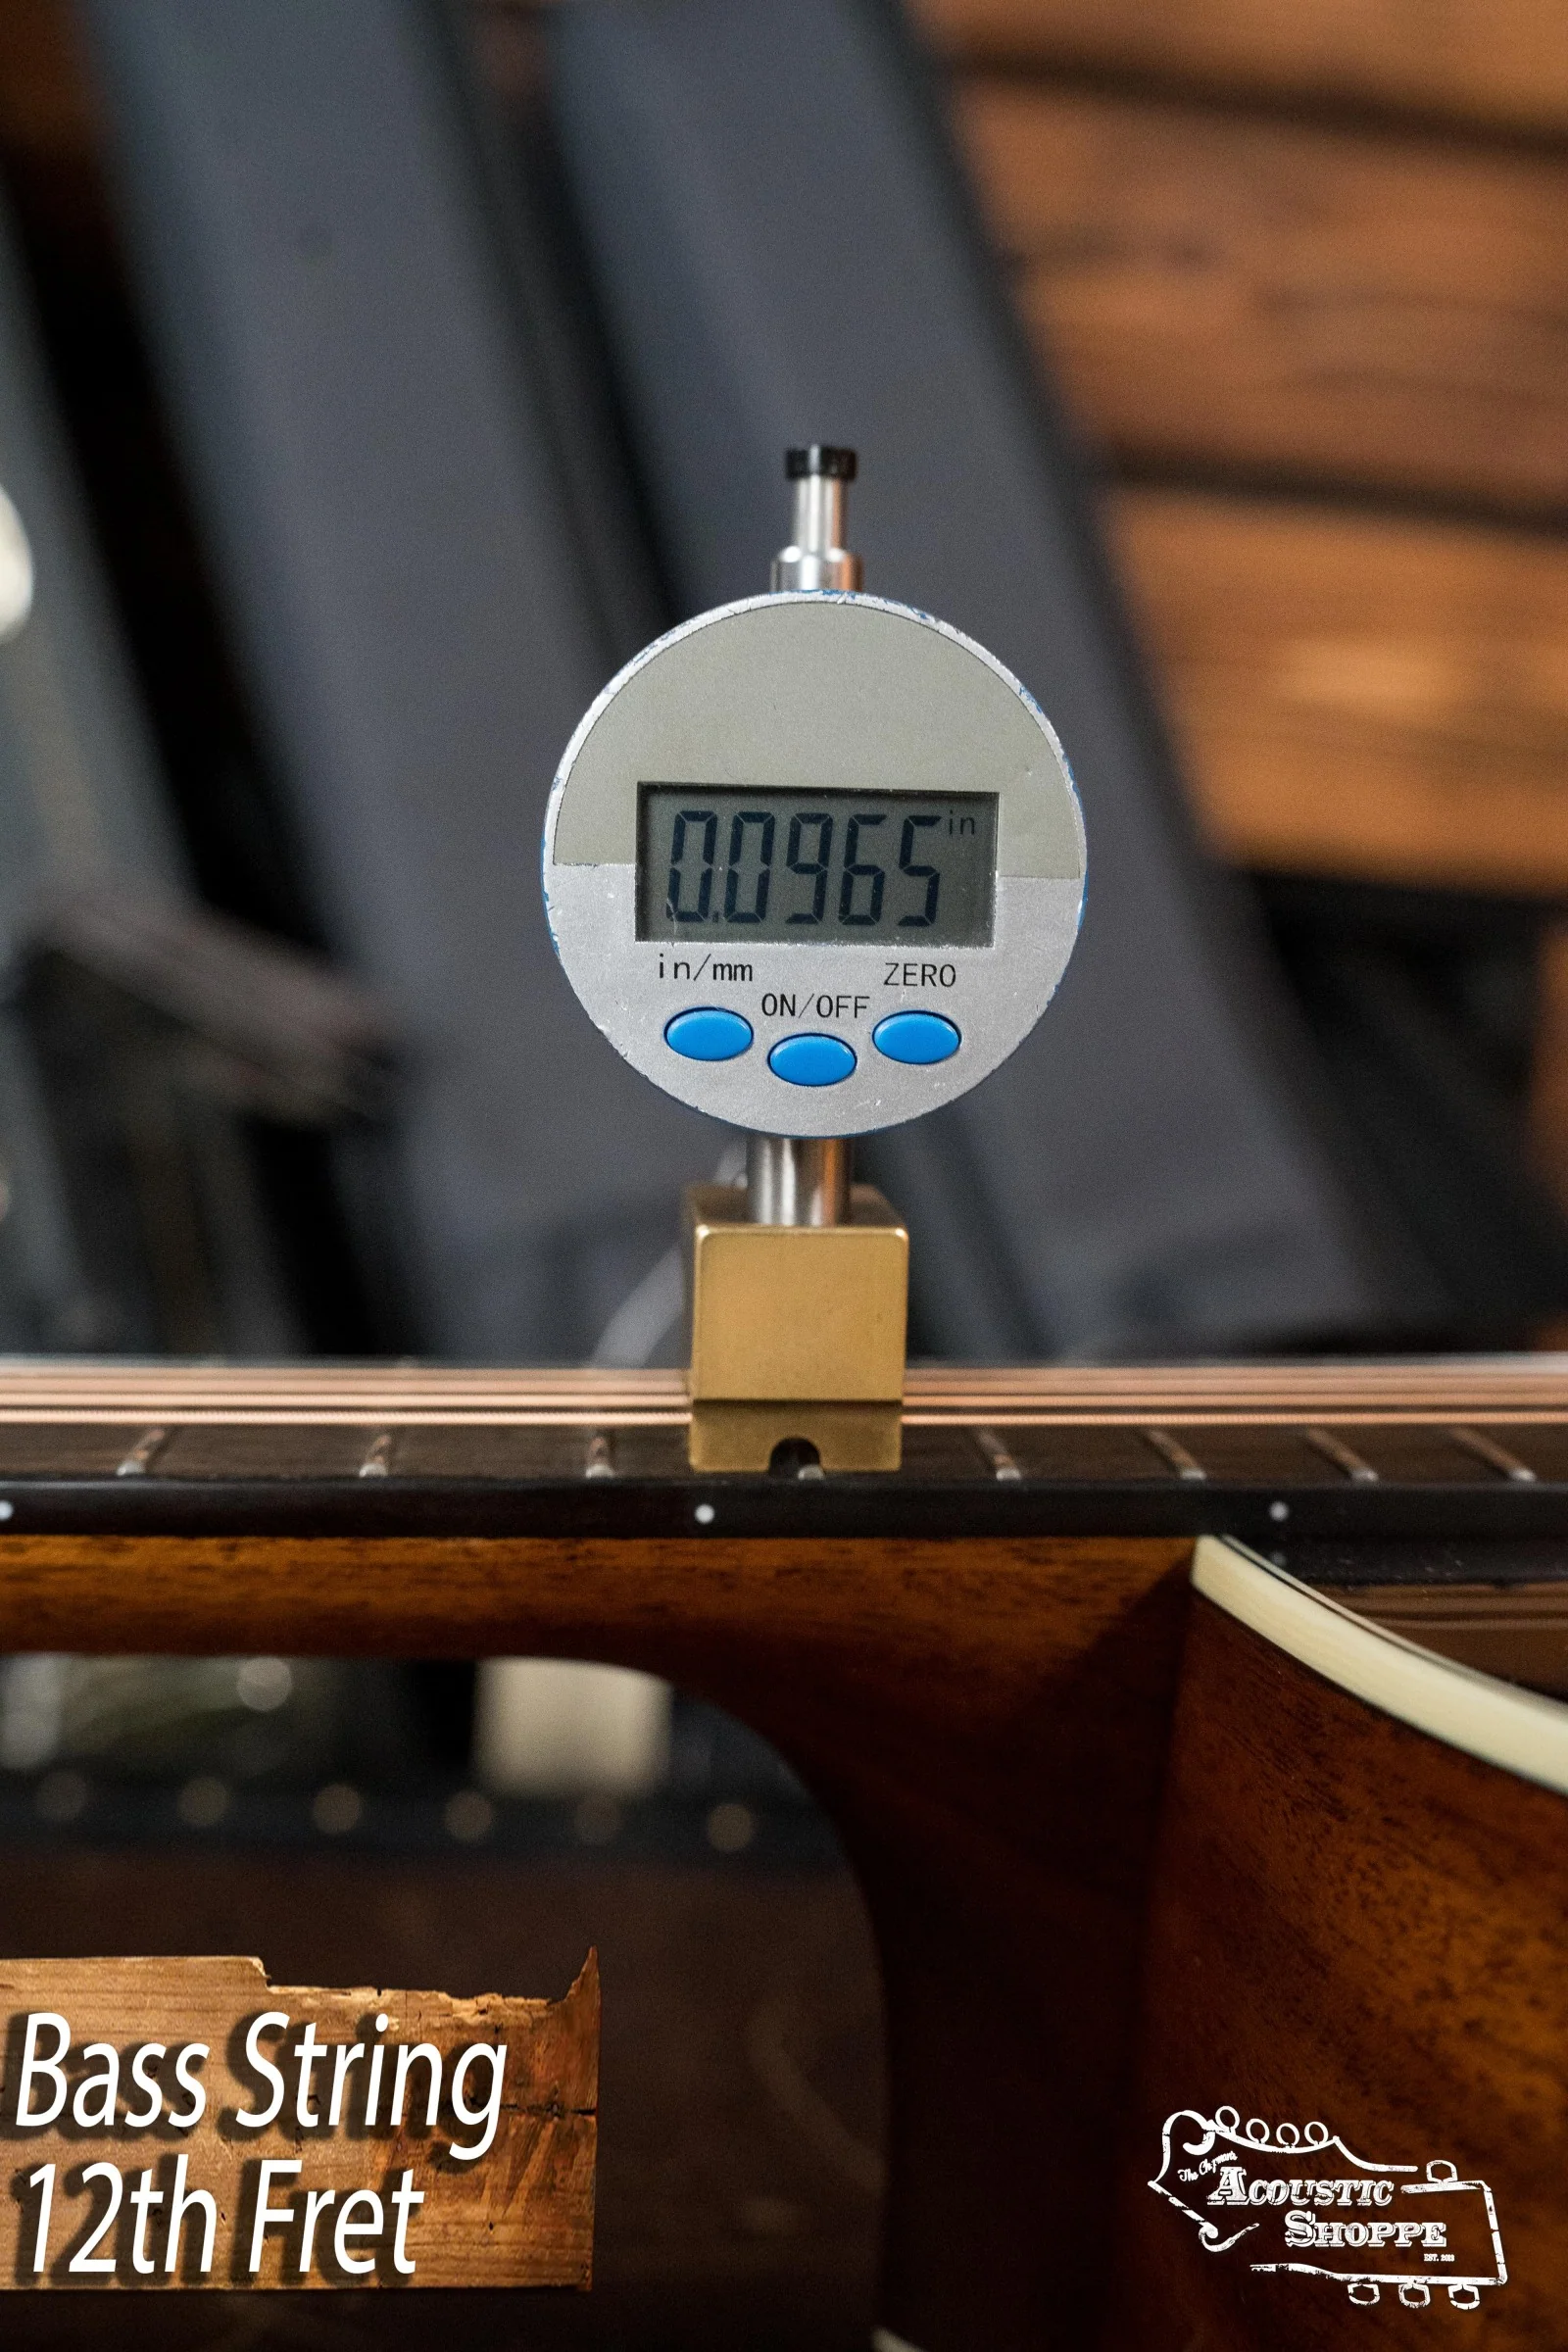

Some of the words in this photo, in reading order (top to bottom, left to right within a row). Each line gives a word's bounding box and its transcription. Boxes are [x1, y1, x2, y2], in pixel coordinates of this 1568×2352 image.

[665, 809, 942, 927] 0.0965
[948, 810, 976, 837] in
[658, 953, 754, 982] in/mm
[883, 961, 956, 988] ZERO
[760, 992, 871, 1019] ON/OFF
